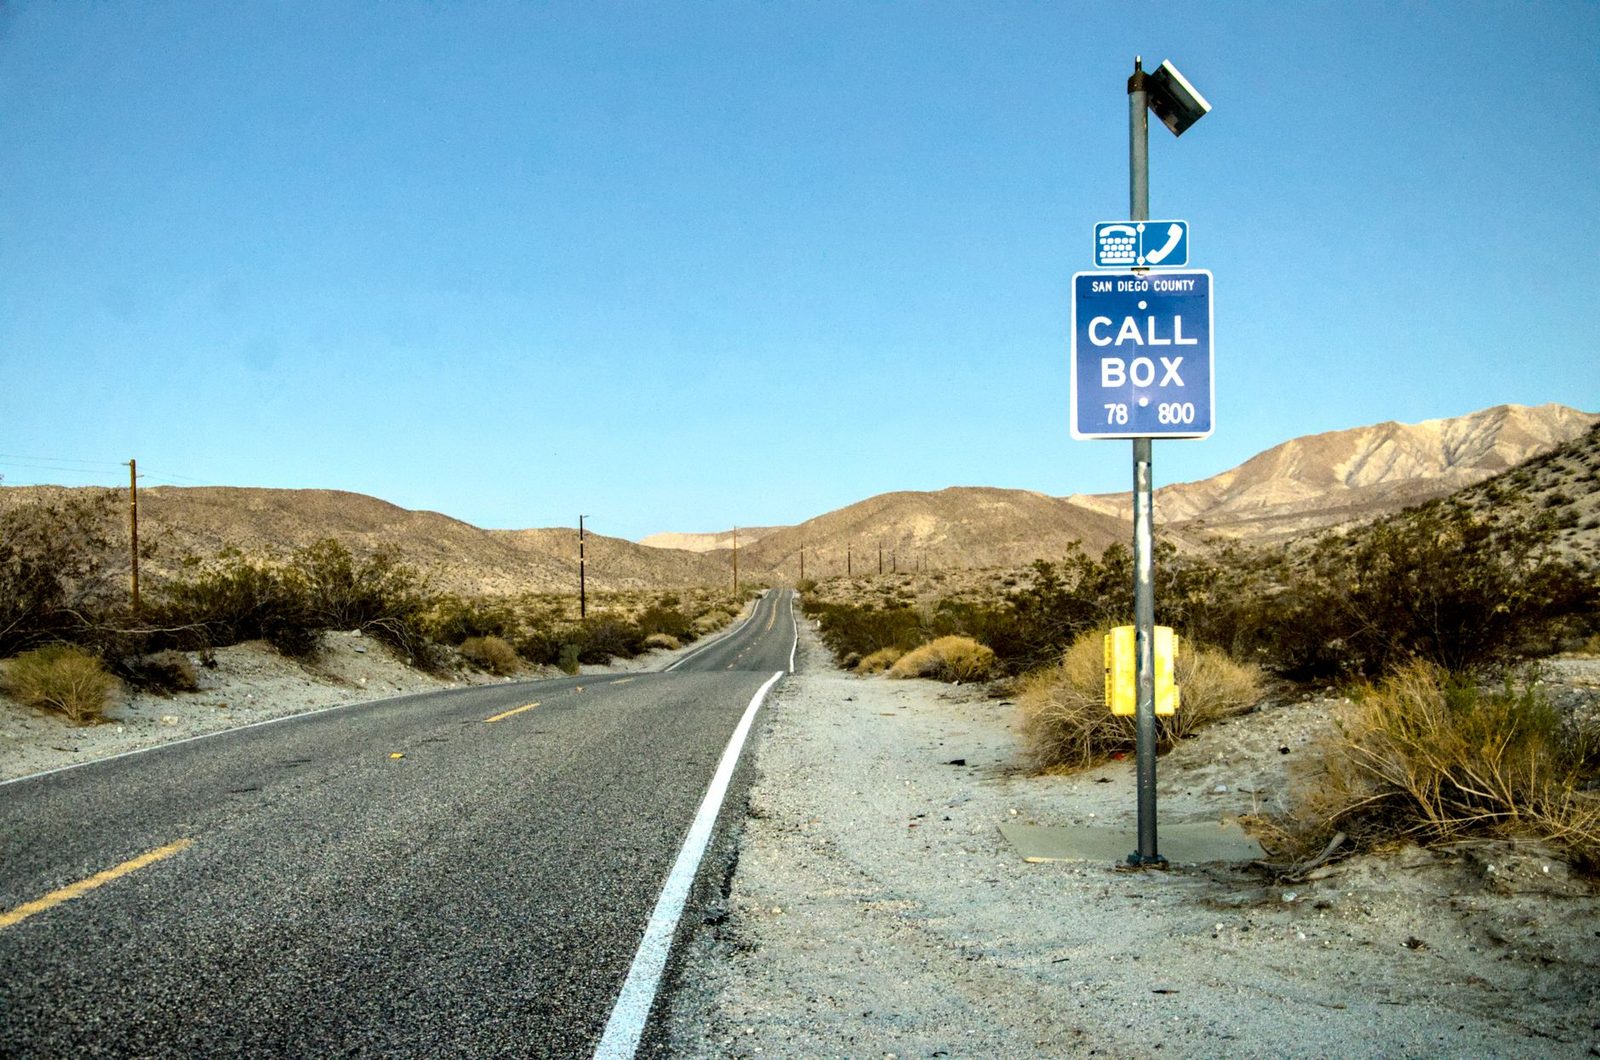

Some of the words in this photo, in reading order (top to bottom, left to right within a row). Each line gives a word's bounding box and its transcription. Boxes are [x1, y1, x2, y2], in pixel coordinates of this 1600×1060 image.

[1092, 281, 1112, 292] SAN
[1118, 280, 1148, 292] DIEGO
[1153, 279, 1195, 292] COUNTY
[1088, 315, 1198, 346] CALL
[1101, 357, 1185, 388] BOX
[1104, 403, 1128, 425] 78
[1158, 402, 1195, 425] 800
